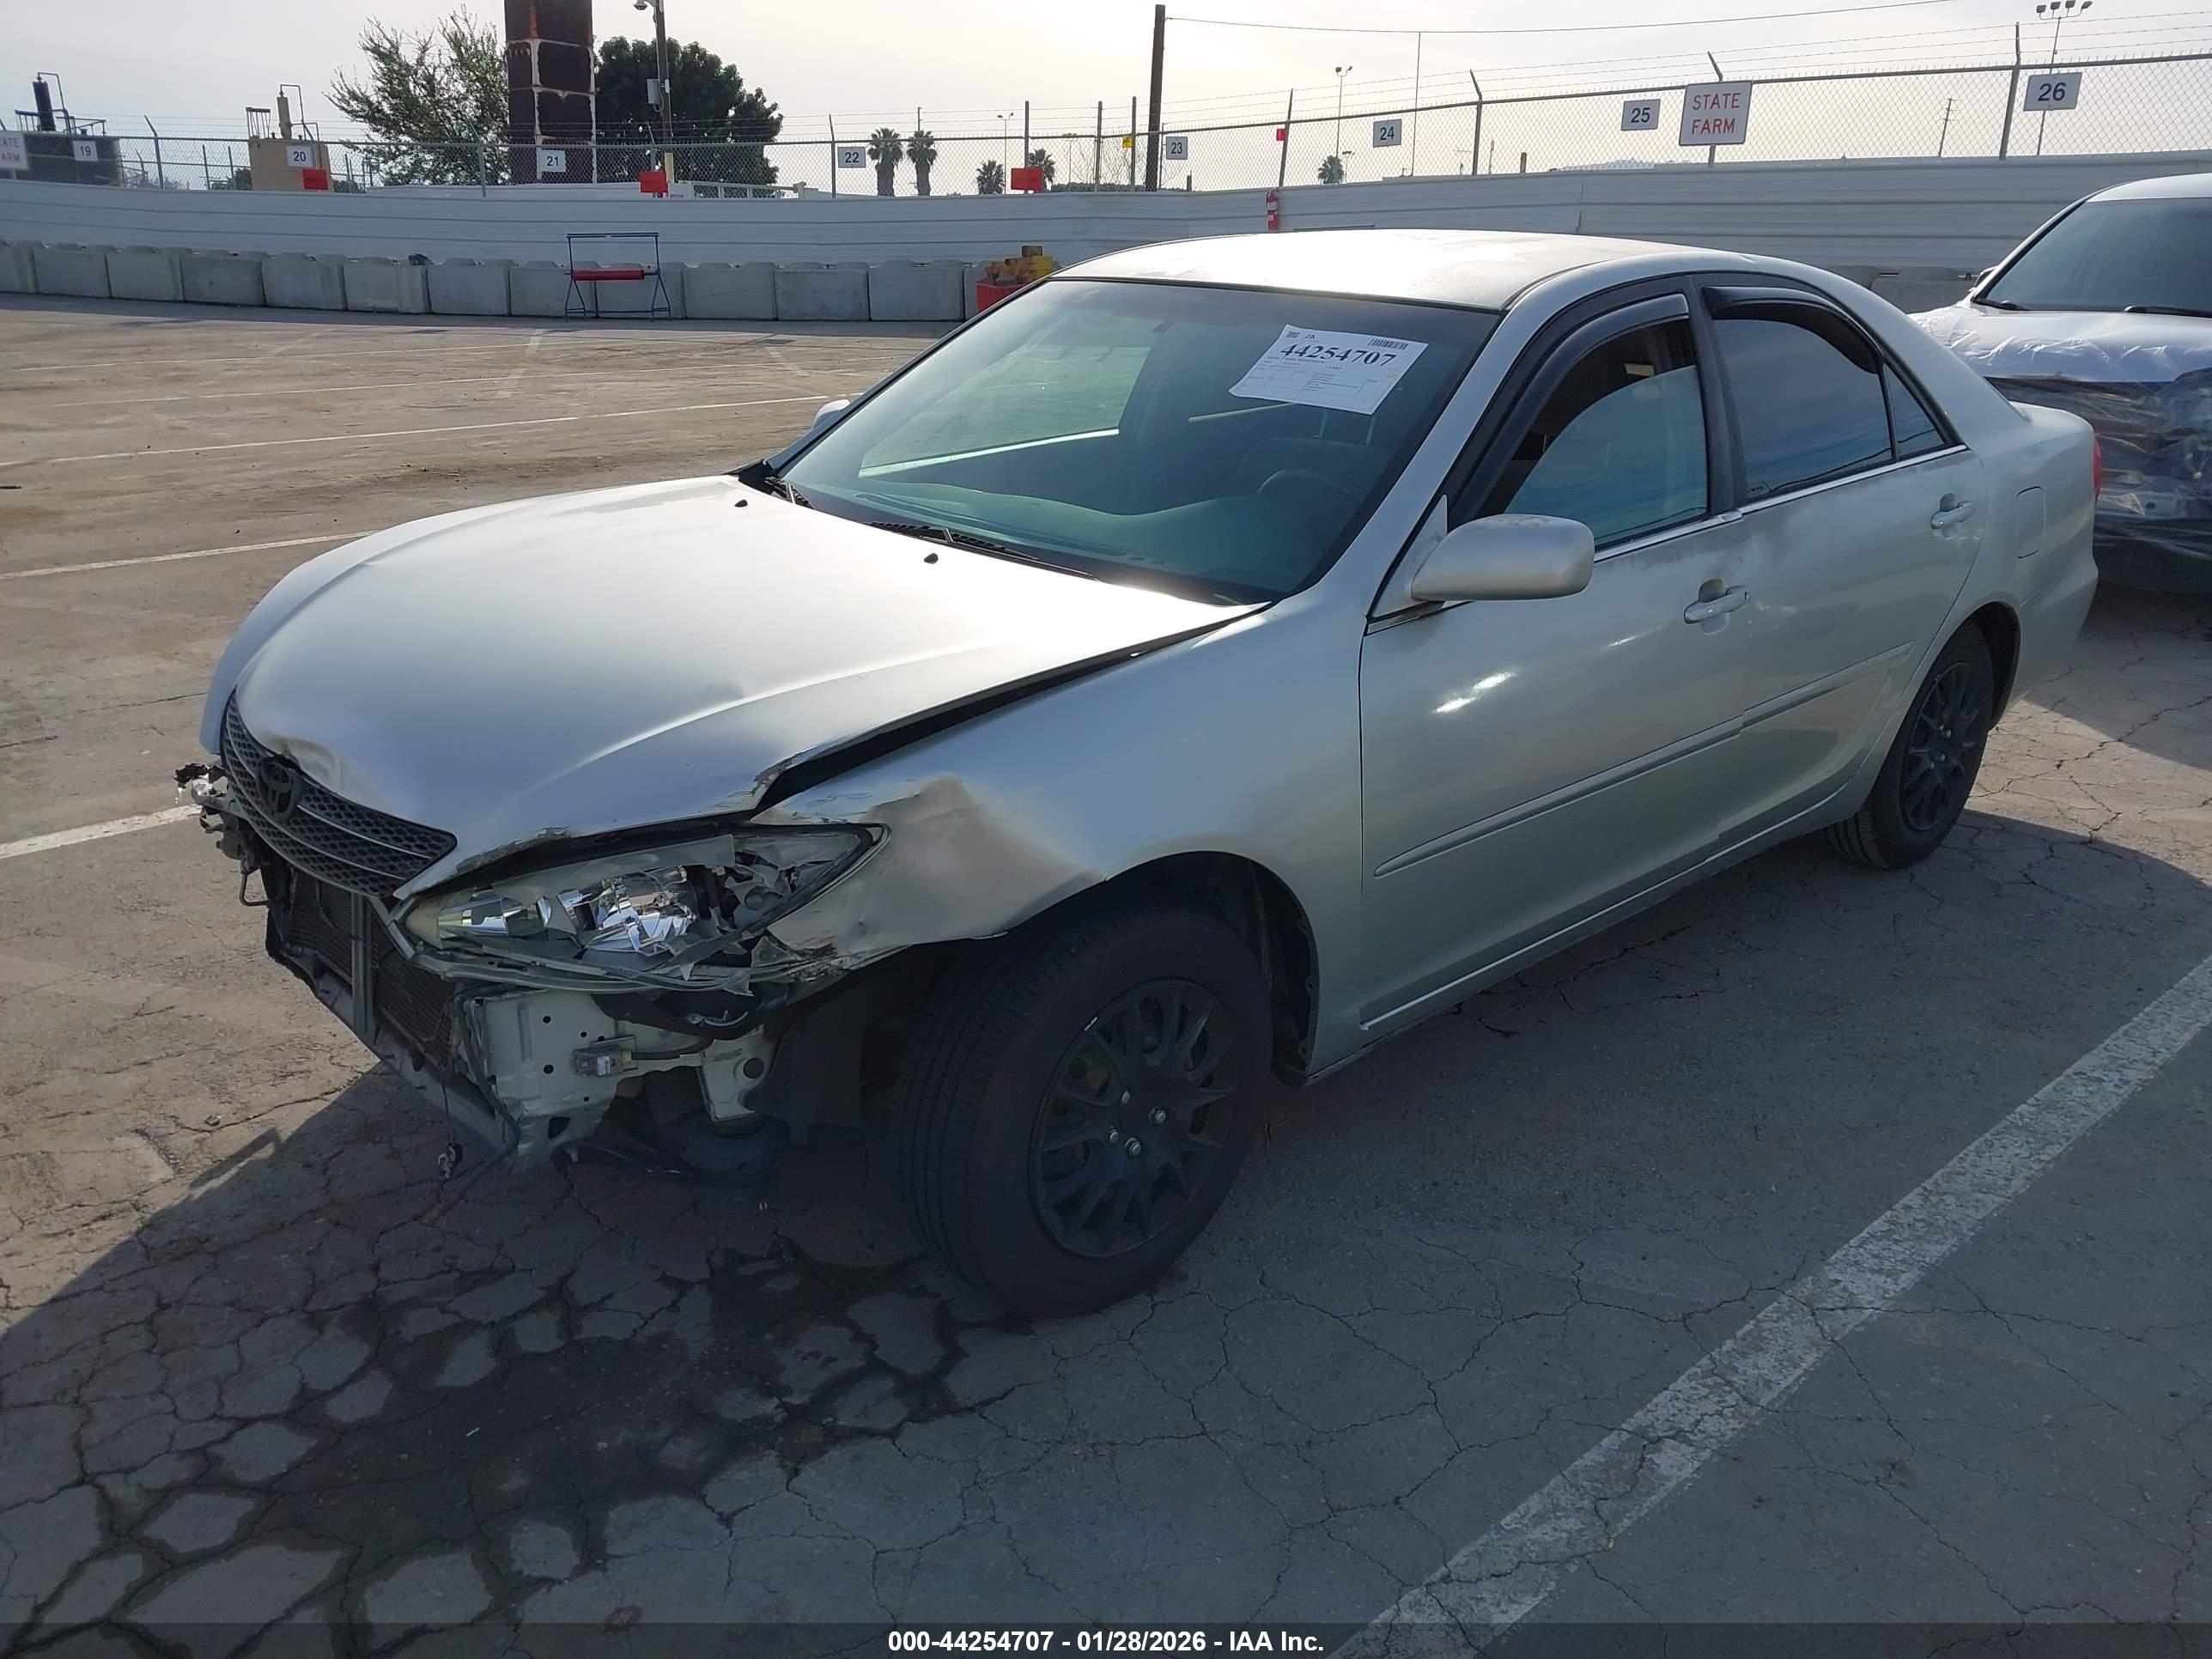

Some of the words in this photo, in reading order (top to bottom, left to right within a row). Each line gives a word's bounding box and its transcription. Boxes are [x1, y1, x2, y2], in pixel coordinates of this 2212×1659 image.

[2038, 82, 2067, 101] 26
[1692, 93, 1741, 110] STATE
[1631, 107, 1650, 123] 25
[1692, 118, 1735, 134] FARM
[1380, 126, 1395, 140] 24
[0, 137, 19, 148] ATE
[1171, 142, 1182, 154] 23
[81, 145, 91, 156] 19
[293, 151, 307, 161] 20
[0, 152, 21, 162] ARM
[546, 155, 559, 167] 21
[845, 152, 860, 163] 22
[1280, 343, 1397, 367] 44254707
